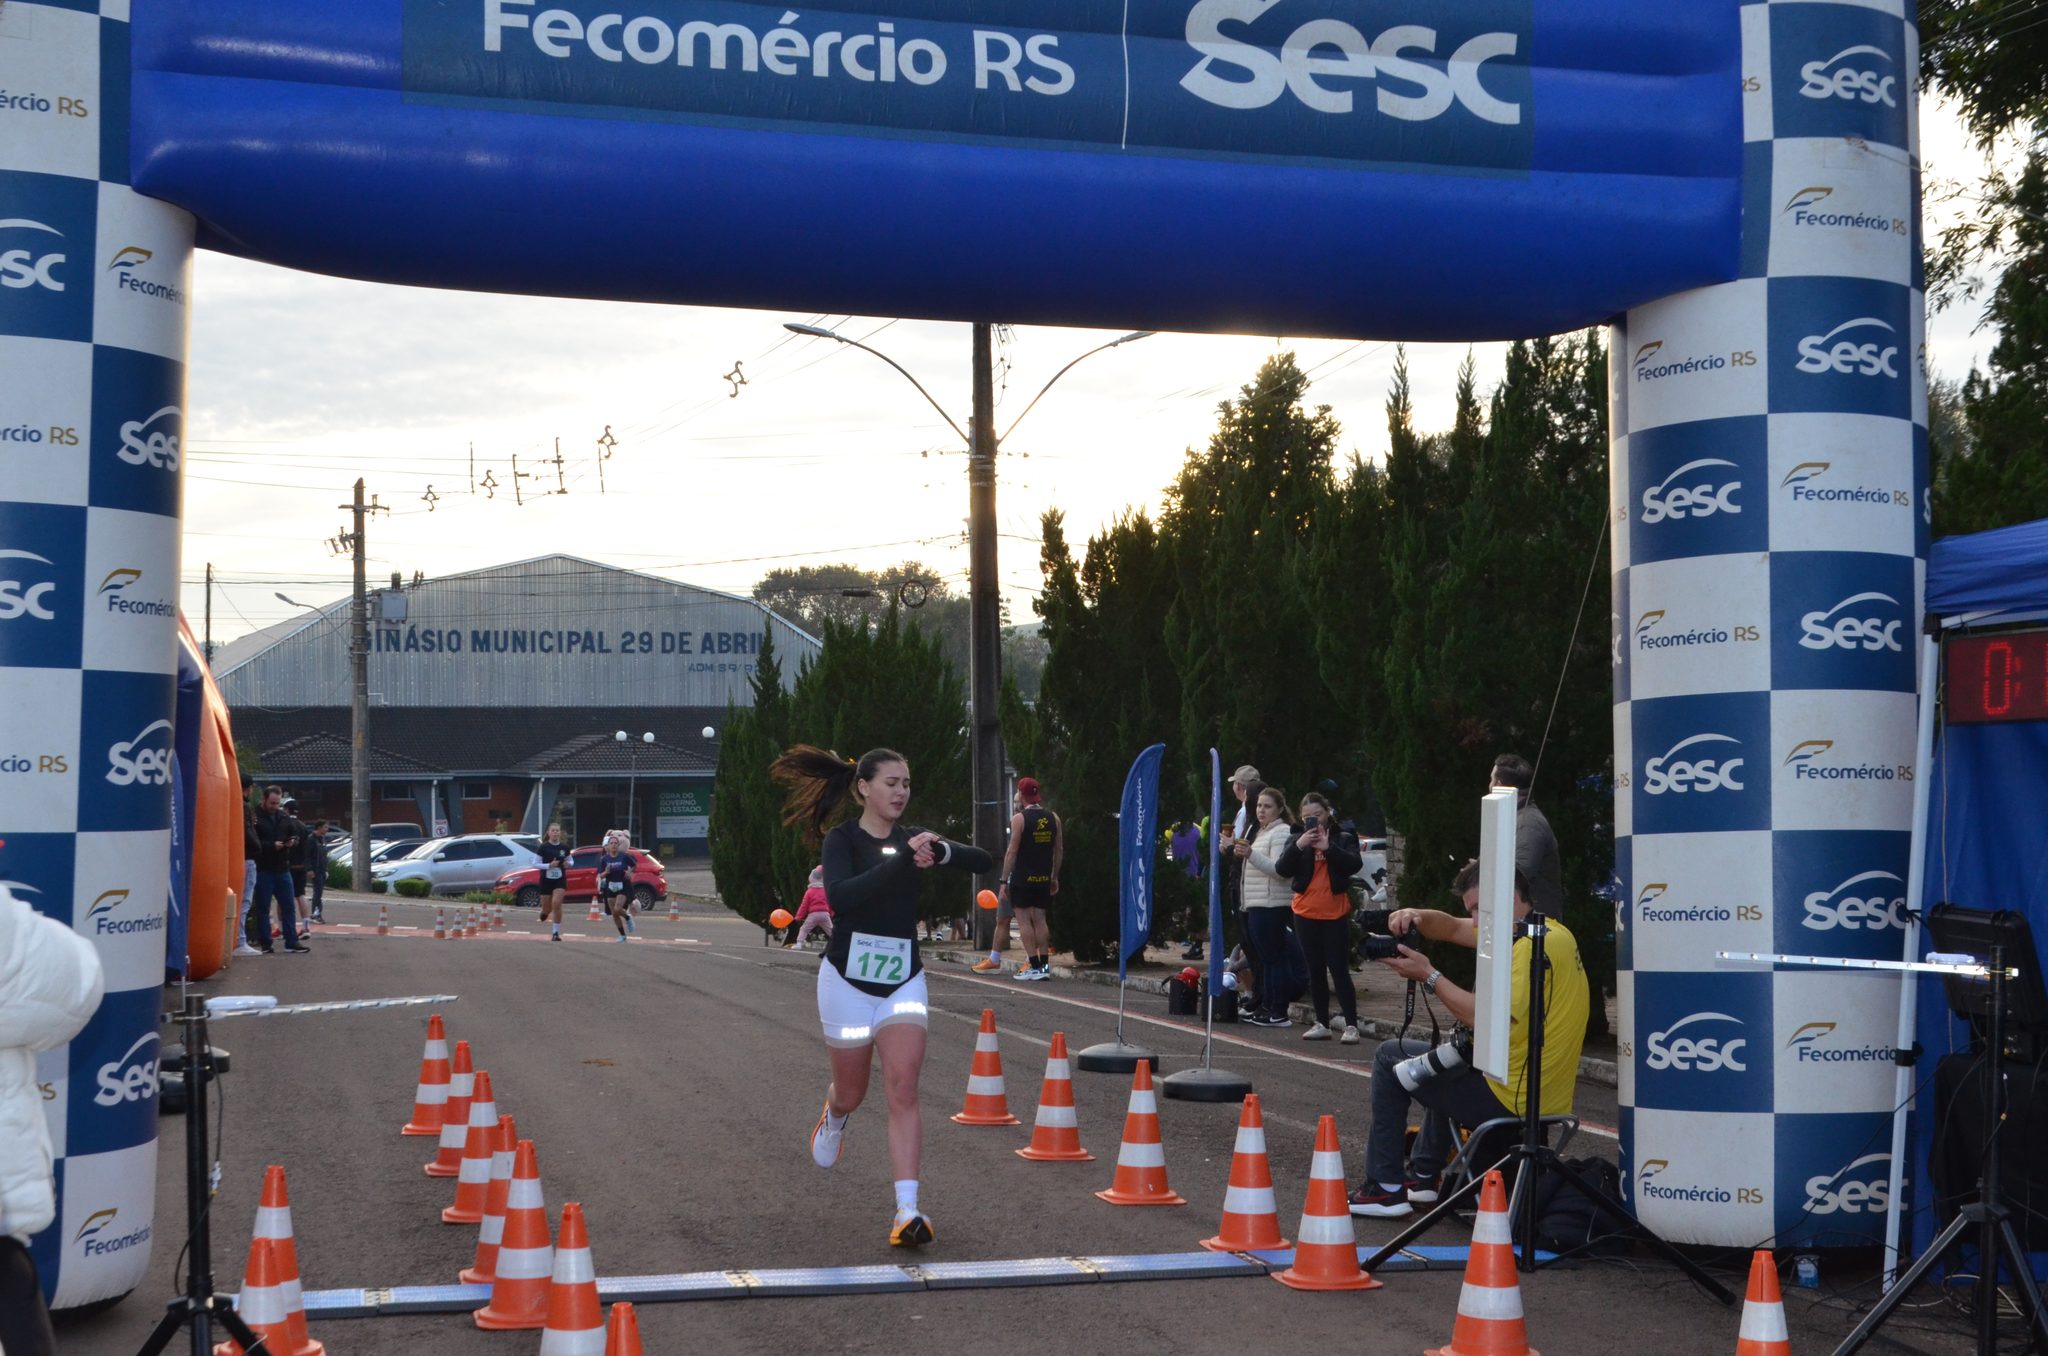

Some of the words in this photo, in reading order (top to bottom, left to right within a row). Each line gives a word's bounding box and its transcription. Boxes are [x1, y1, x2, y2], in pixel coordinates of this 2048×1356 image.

[483, 0, 947, 86] Fecomércio
[973, 29, 1076, 96] RS
[1179, 0, 1521, 125] Sesc
[1799, 59, 1897, 108] Sesc
[58, 97, 88, 118] RS
[1795, 210, 1889, 231] Fecomércio
[1892, 218, 1907, 236] RS
[1637, 356, 1725, 382] Fecomércio
[1731, 350, 1758, 367] RS
[1795, 333, 1898, 379] Sesc
[50, 426, 79, 446] RS
[1641, 480, 1742, 524] Sesc
[1793, 486, 1890, 504] Fecomércio
[1893, 490, 1909, 507] RS
[471, 630, 612, 653] MUNICIPAL
[621, 631, 653, 654] 29
[661, 632, 692, 654] DE
[1640, 628, 1728, 650] Fecomércio
[1733, 626, 1760, 642] RS
[1798, 610, 1902, 652] Sesc
[39, 755, 68, 773] RS
[1643, 756, 1744, 795] Sesc
[1796, 763, 1894, 780] Fecomércio
[1897, 766, 1913, 781] RS
[1643, 905, 1730, 921] Fecomércio
[1736, 905, 1762, 921] RS
[1801, 890, 1906, 930] Sesc
[858, 952, 904, 981] 172
[1646, 1031, 1746, 1072] Sesc
[1643, 1181, 1731, 1203] Fecomércio
[1737, 1187, 1763, 1204] RS
